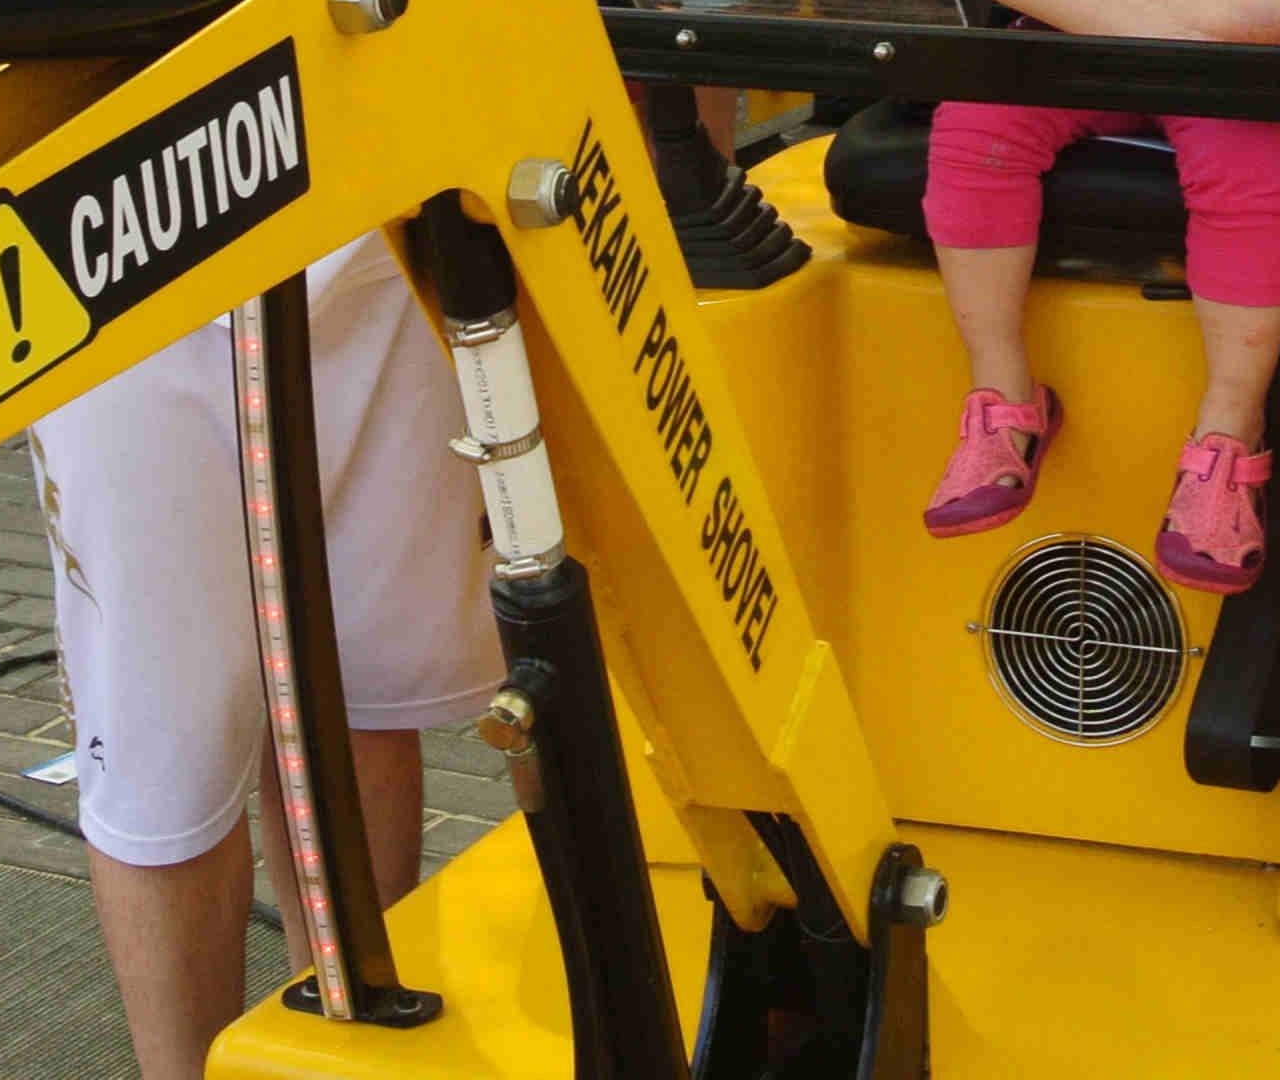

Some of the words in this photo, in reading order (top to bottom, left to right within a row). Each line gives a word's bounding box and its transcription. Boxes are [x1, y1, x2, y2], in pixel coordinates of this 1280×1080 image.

[70, 74, 300, 298] CAUTION
[570, 116, 648, 336] VEKAIN
[633, 306, 713, 506] POWER
[701, 476, 779, 673] SHOVEL
